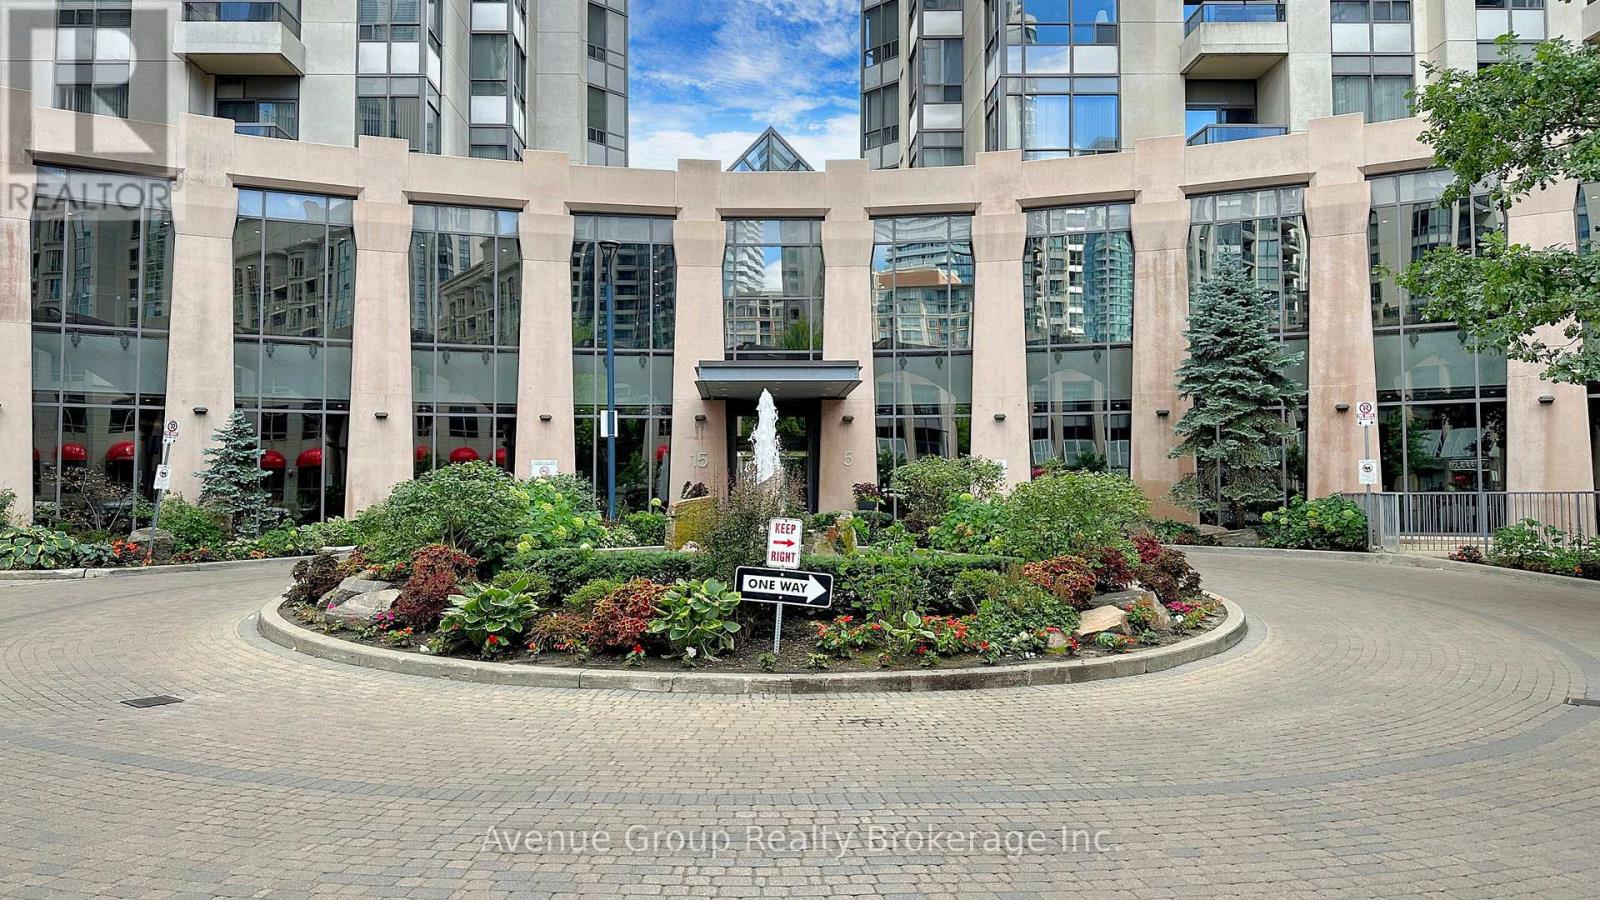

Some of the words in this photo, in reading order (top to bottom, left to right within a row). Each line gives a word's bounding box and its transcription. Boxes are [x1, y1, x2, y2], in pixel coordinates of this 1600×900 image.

[690, 452, 708, 467] 15
[774, 522, 796, 535] KEEP
[770, 550, 796, 563] RIGHT
[748, 578, 776, 590] ONE
[780, 581, 808, 593] WAY
